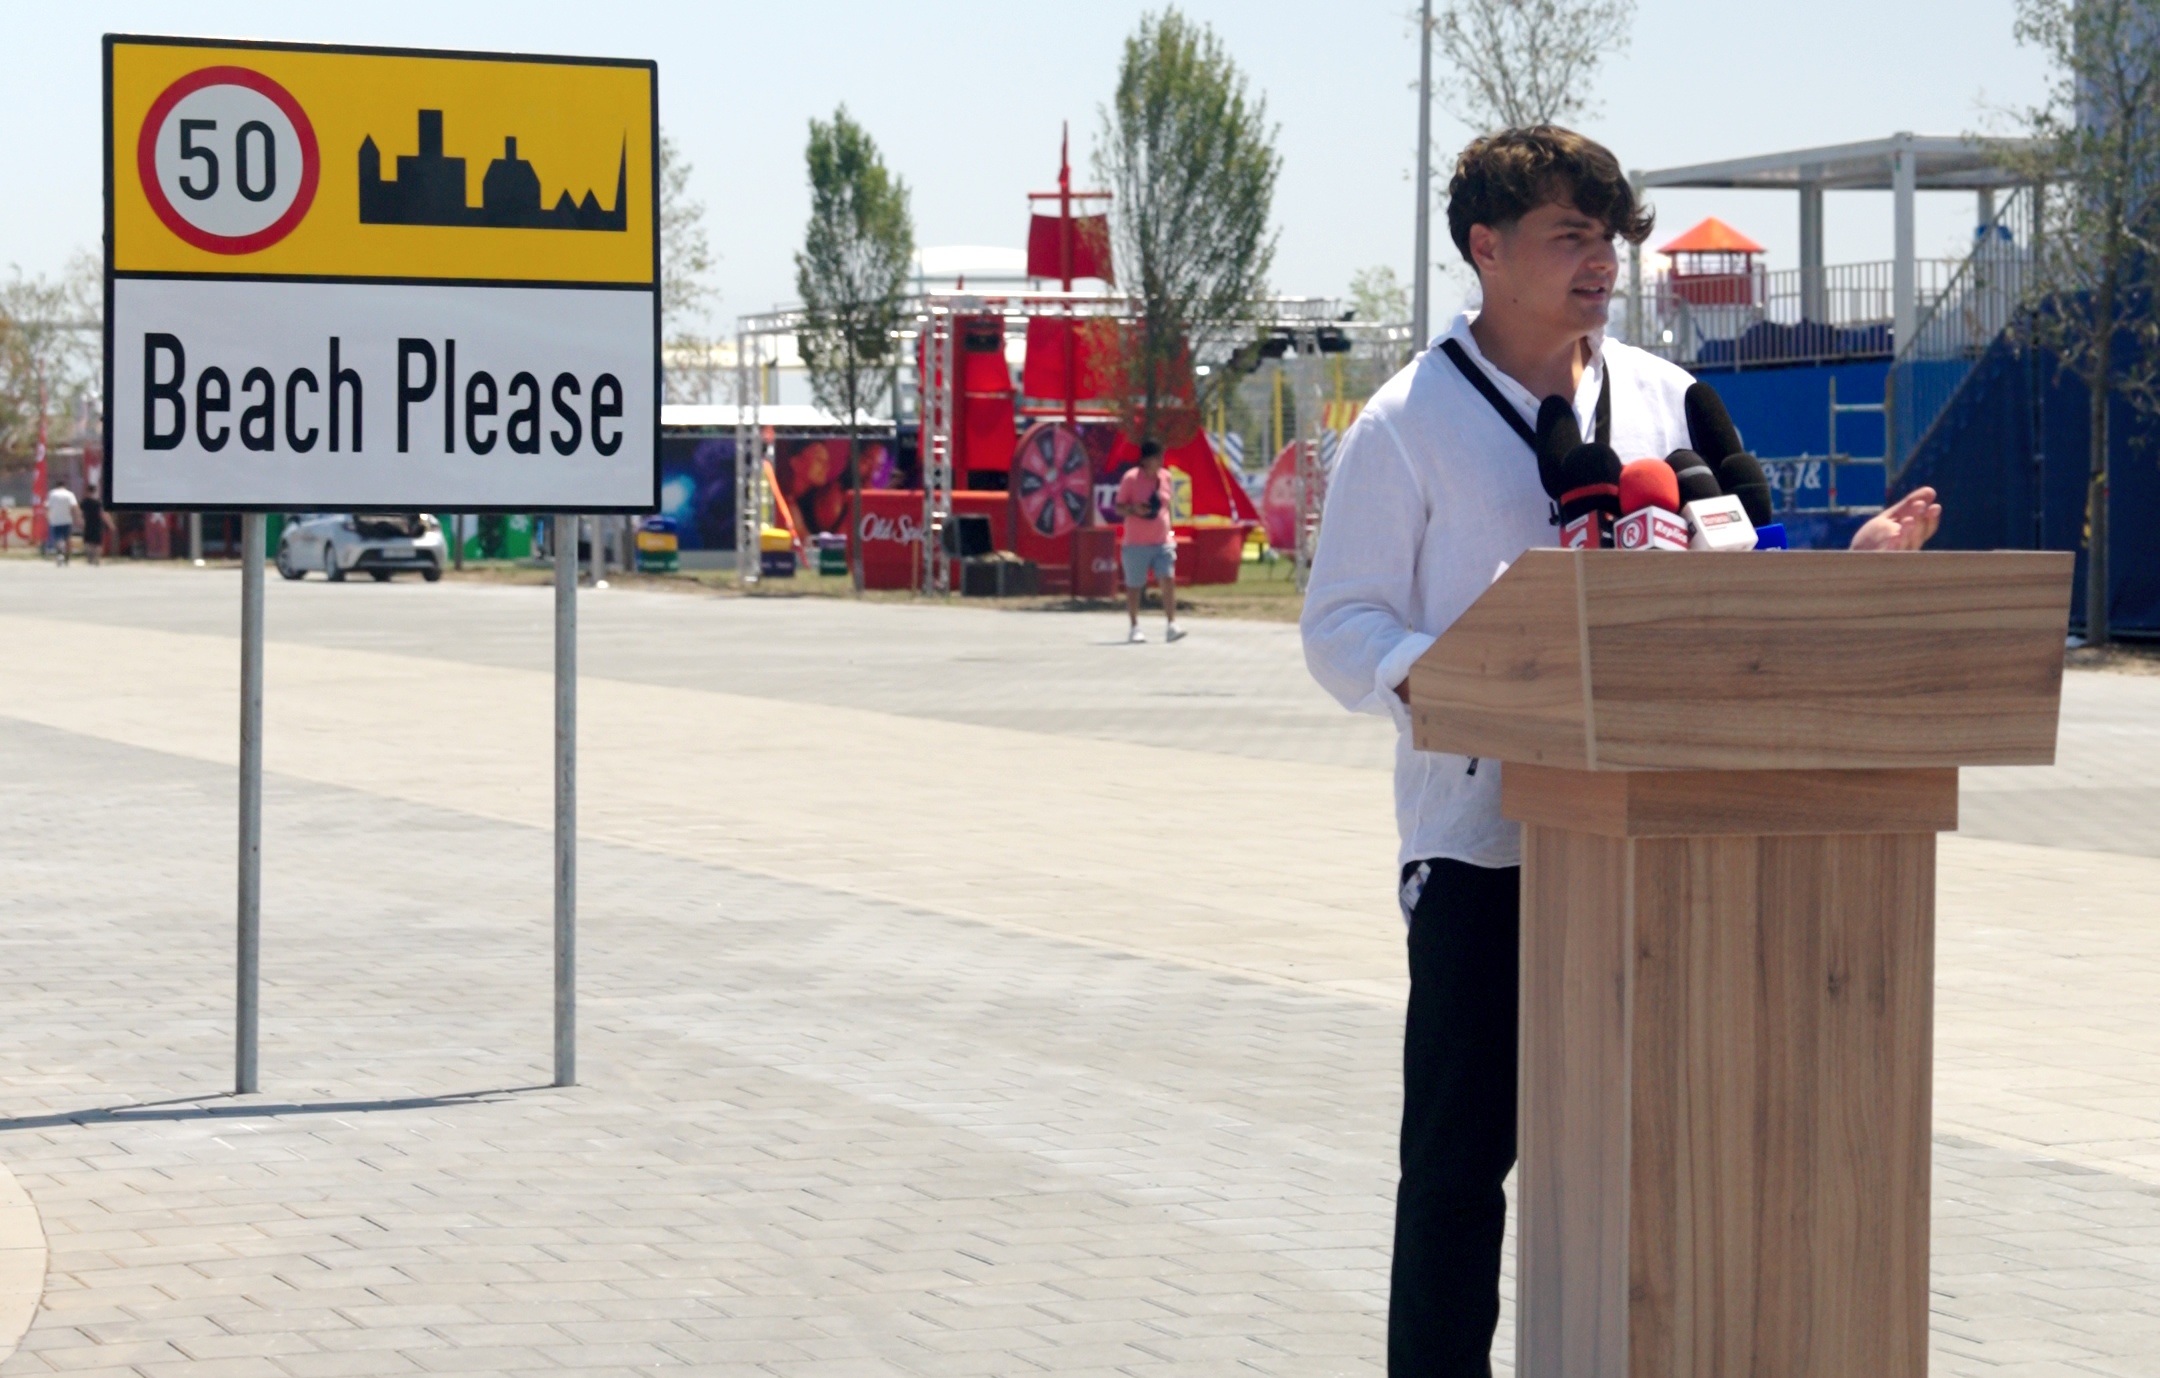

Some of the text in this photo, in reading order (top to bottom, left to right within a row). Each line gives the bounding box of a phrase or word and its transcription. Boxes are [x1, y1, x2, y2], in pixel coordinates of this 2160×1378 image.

[178, 118, 276, 203] 50
[143, 331, 624, 458] Beach Please
[1626, 526, 1636, 543] R
